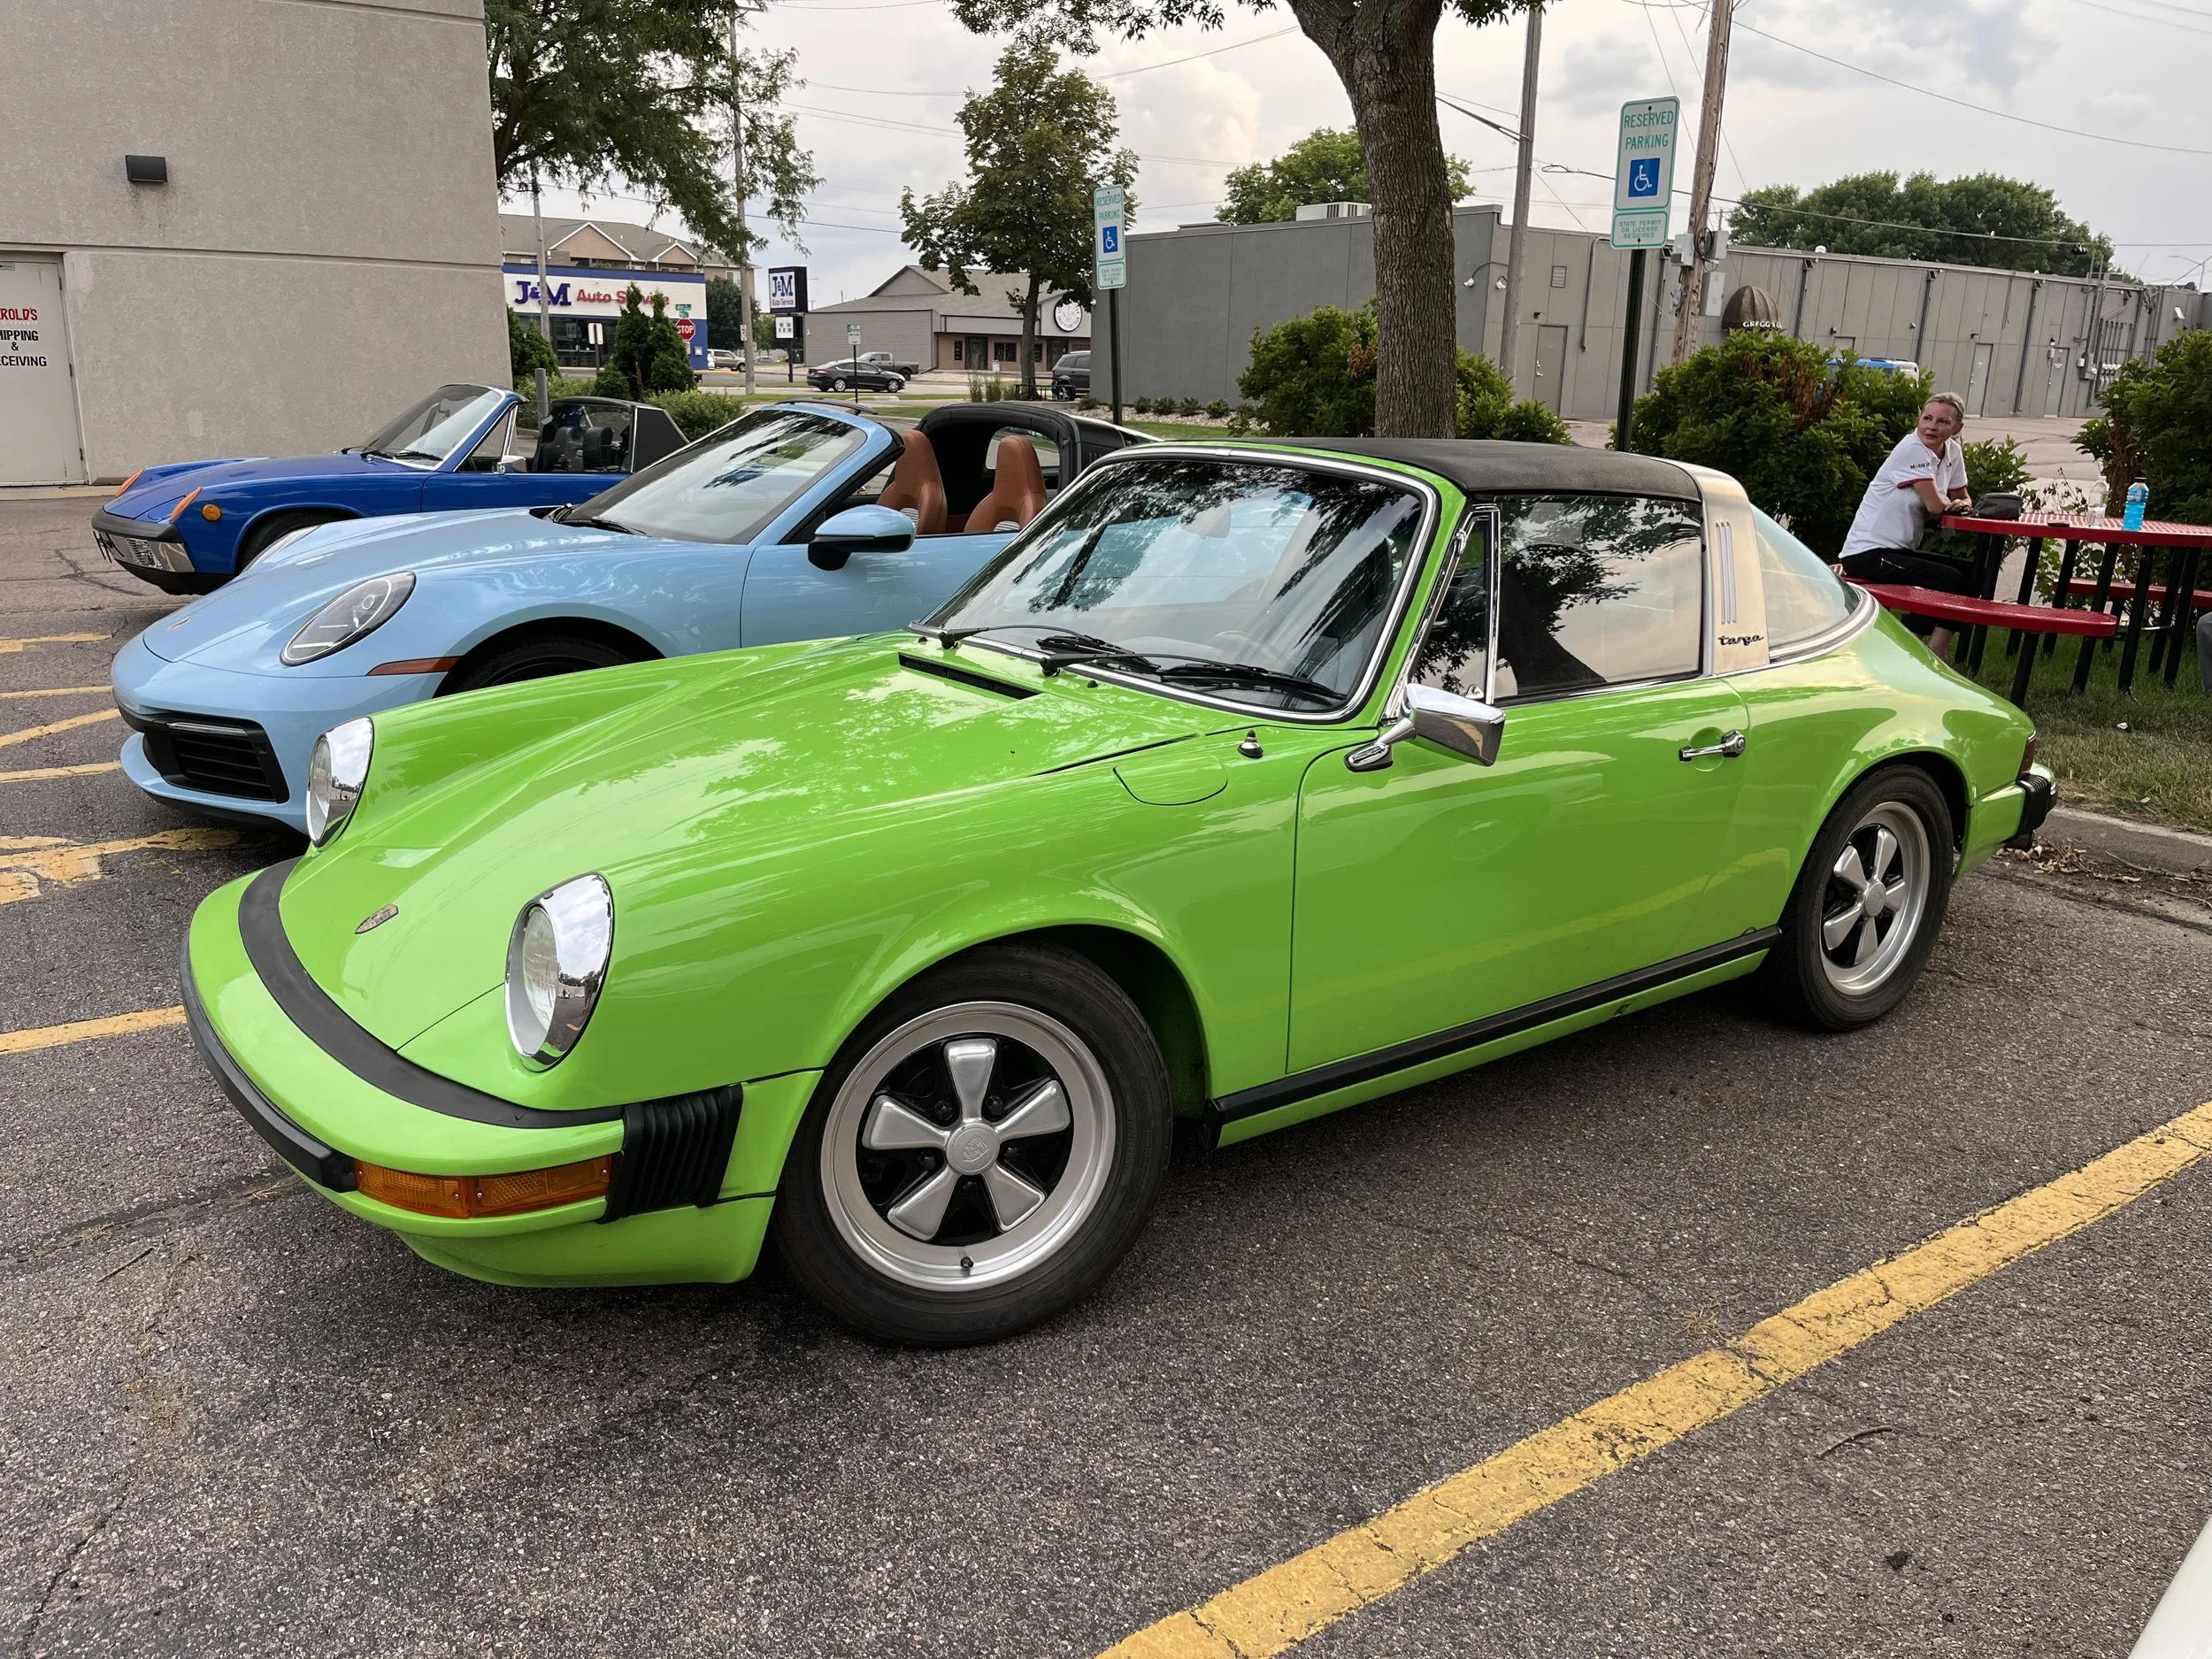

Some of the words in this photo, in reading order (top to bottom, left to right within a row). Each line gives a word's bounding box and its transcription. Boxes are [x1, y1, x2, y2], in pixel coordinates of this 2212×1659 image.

[1624, 111, 1673, 128] RESERVED
[1625, 134, 1669, 150] PARKING
[1096, 194, 1122, 206] RESERVED
[1098, 209, 1120, 221] PARKING
[772, 275, 794, 297] J&M
[577, 289, 611, 303] Auto
[0, 307, 38, 321] ROLD'S
[677, 325, 695, 334] STOP
[12, 342, 19, 351] &
[0, 355, 47, 366] CEIVING
[1717, 635, 1764, 646] targa
